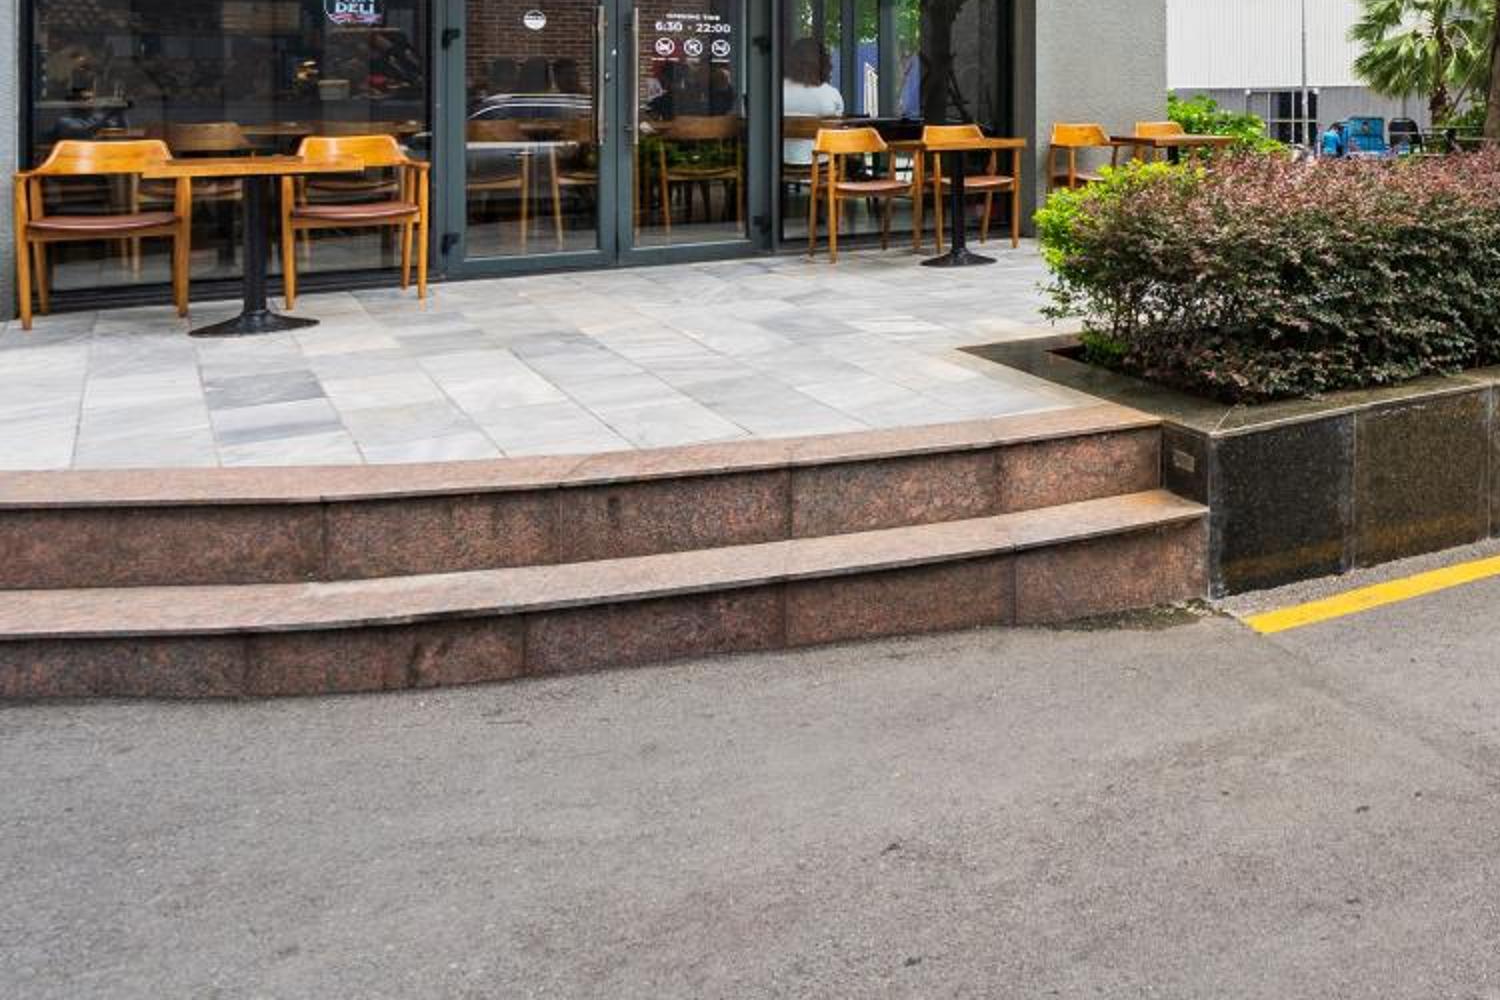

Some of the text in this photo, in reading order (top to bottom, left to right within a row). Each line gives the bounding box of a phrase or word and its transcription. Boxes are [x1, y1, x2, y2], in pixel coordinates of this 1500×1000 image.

[335, 2, 375, 14] DELI
[656, 21, 683, 31] 6:30
[696, 23, 731, 33] 22:00
